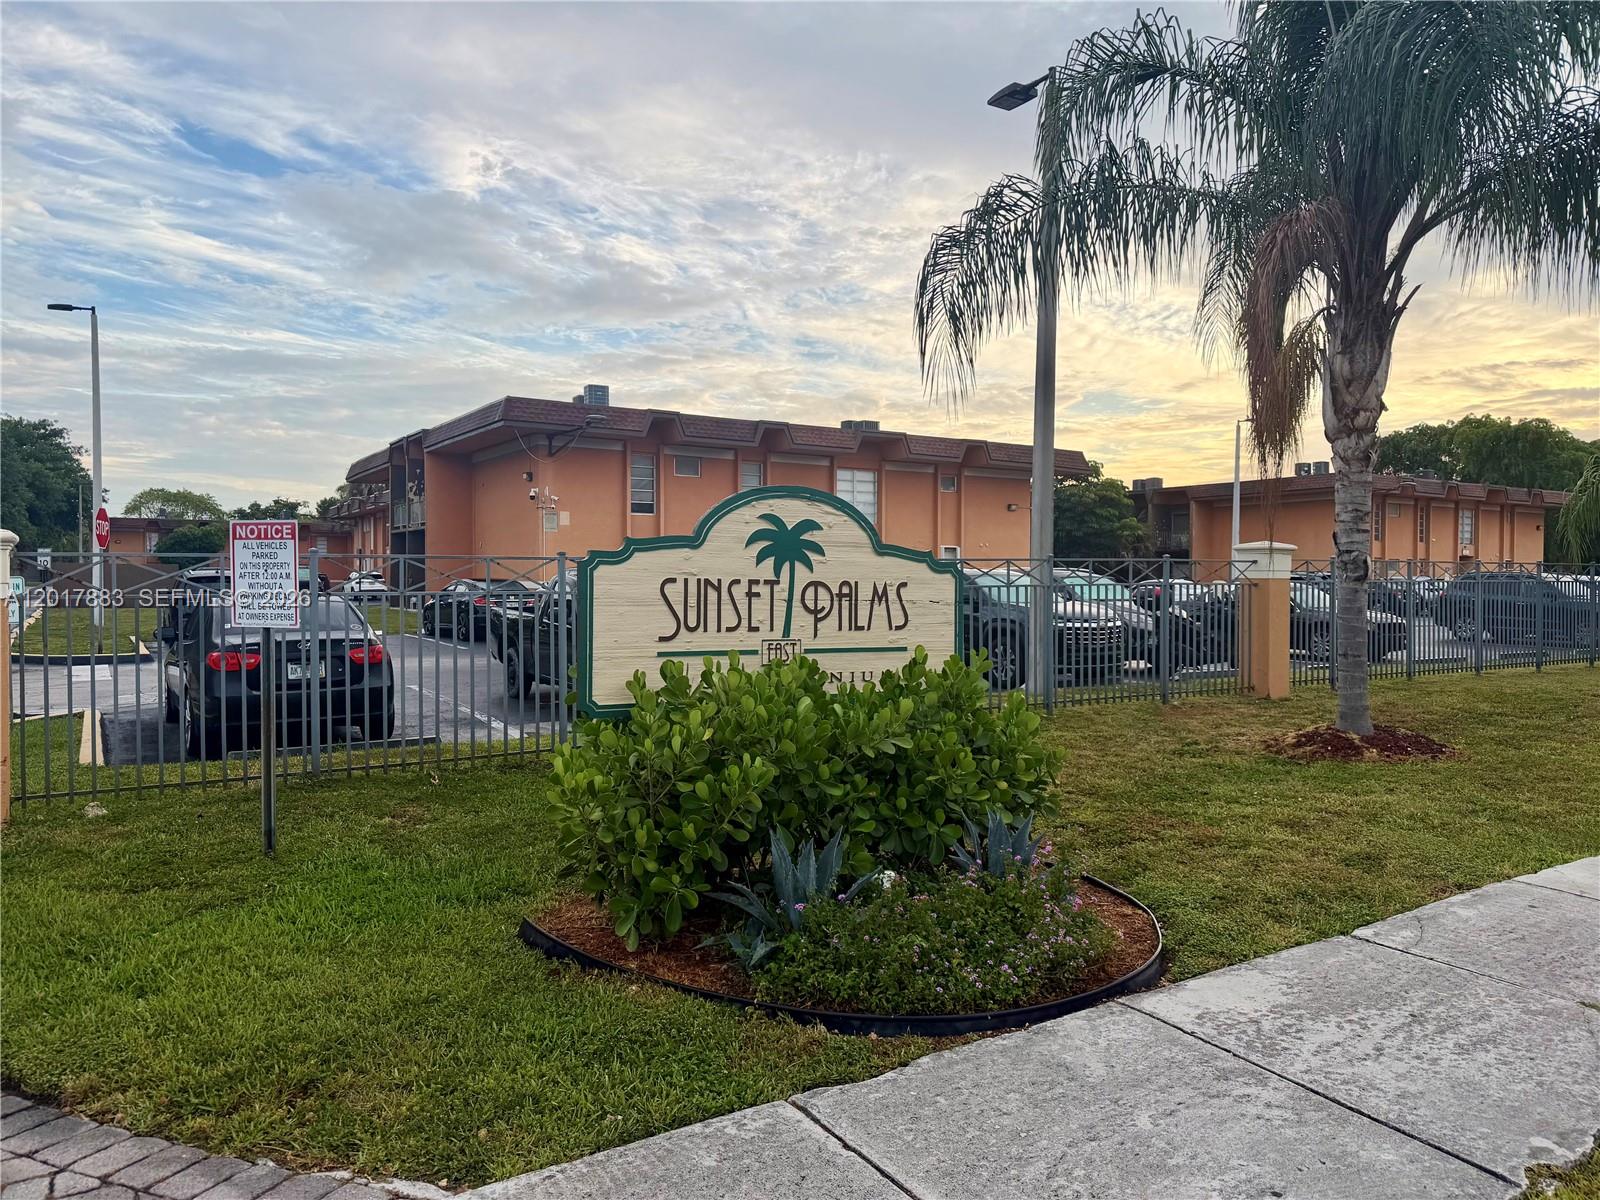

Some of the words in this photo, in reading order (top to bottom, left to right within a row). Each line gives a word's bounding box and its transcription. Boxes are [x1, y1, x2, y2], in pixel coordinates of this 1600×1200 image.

[96, 519, 109, 535] STOP
[236, 525, 292, 538] NOTICE
[242, 542, 255, 550] ALL
[256, 542, 288, 550] VEHICLES
[251, 552, 278, 560] PARKED
[239, 562, 248, 570] ON
[249, 562, 261, 570] THIS
[262, 562, 290, 570] PROPERTY
[239, 571, 260, 580] AFTER
[262, 571, 278, 580] 12:00
[247, 582, 277, 590] WITHOUT
[278, 582, 283, 590] A
[657, 577, 780, 642] SUNSET
[801, 580, 909, 640] PALMS
[238, 612, 245, 621] AT
[245, 612, 270, 621] OWNERS
[269, 612, 295, 622] EXPENSE
[766, 642, 797, 662] EAST
